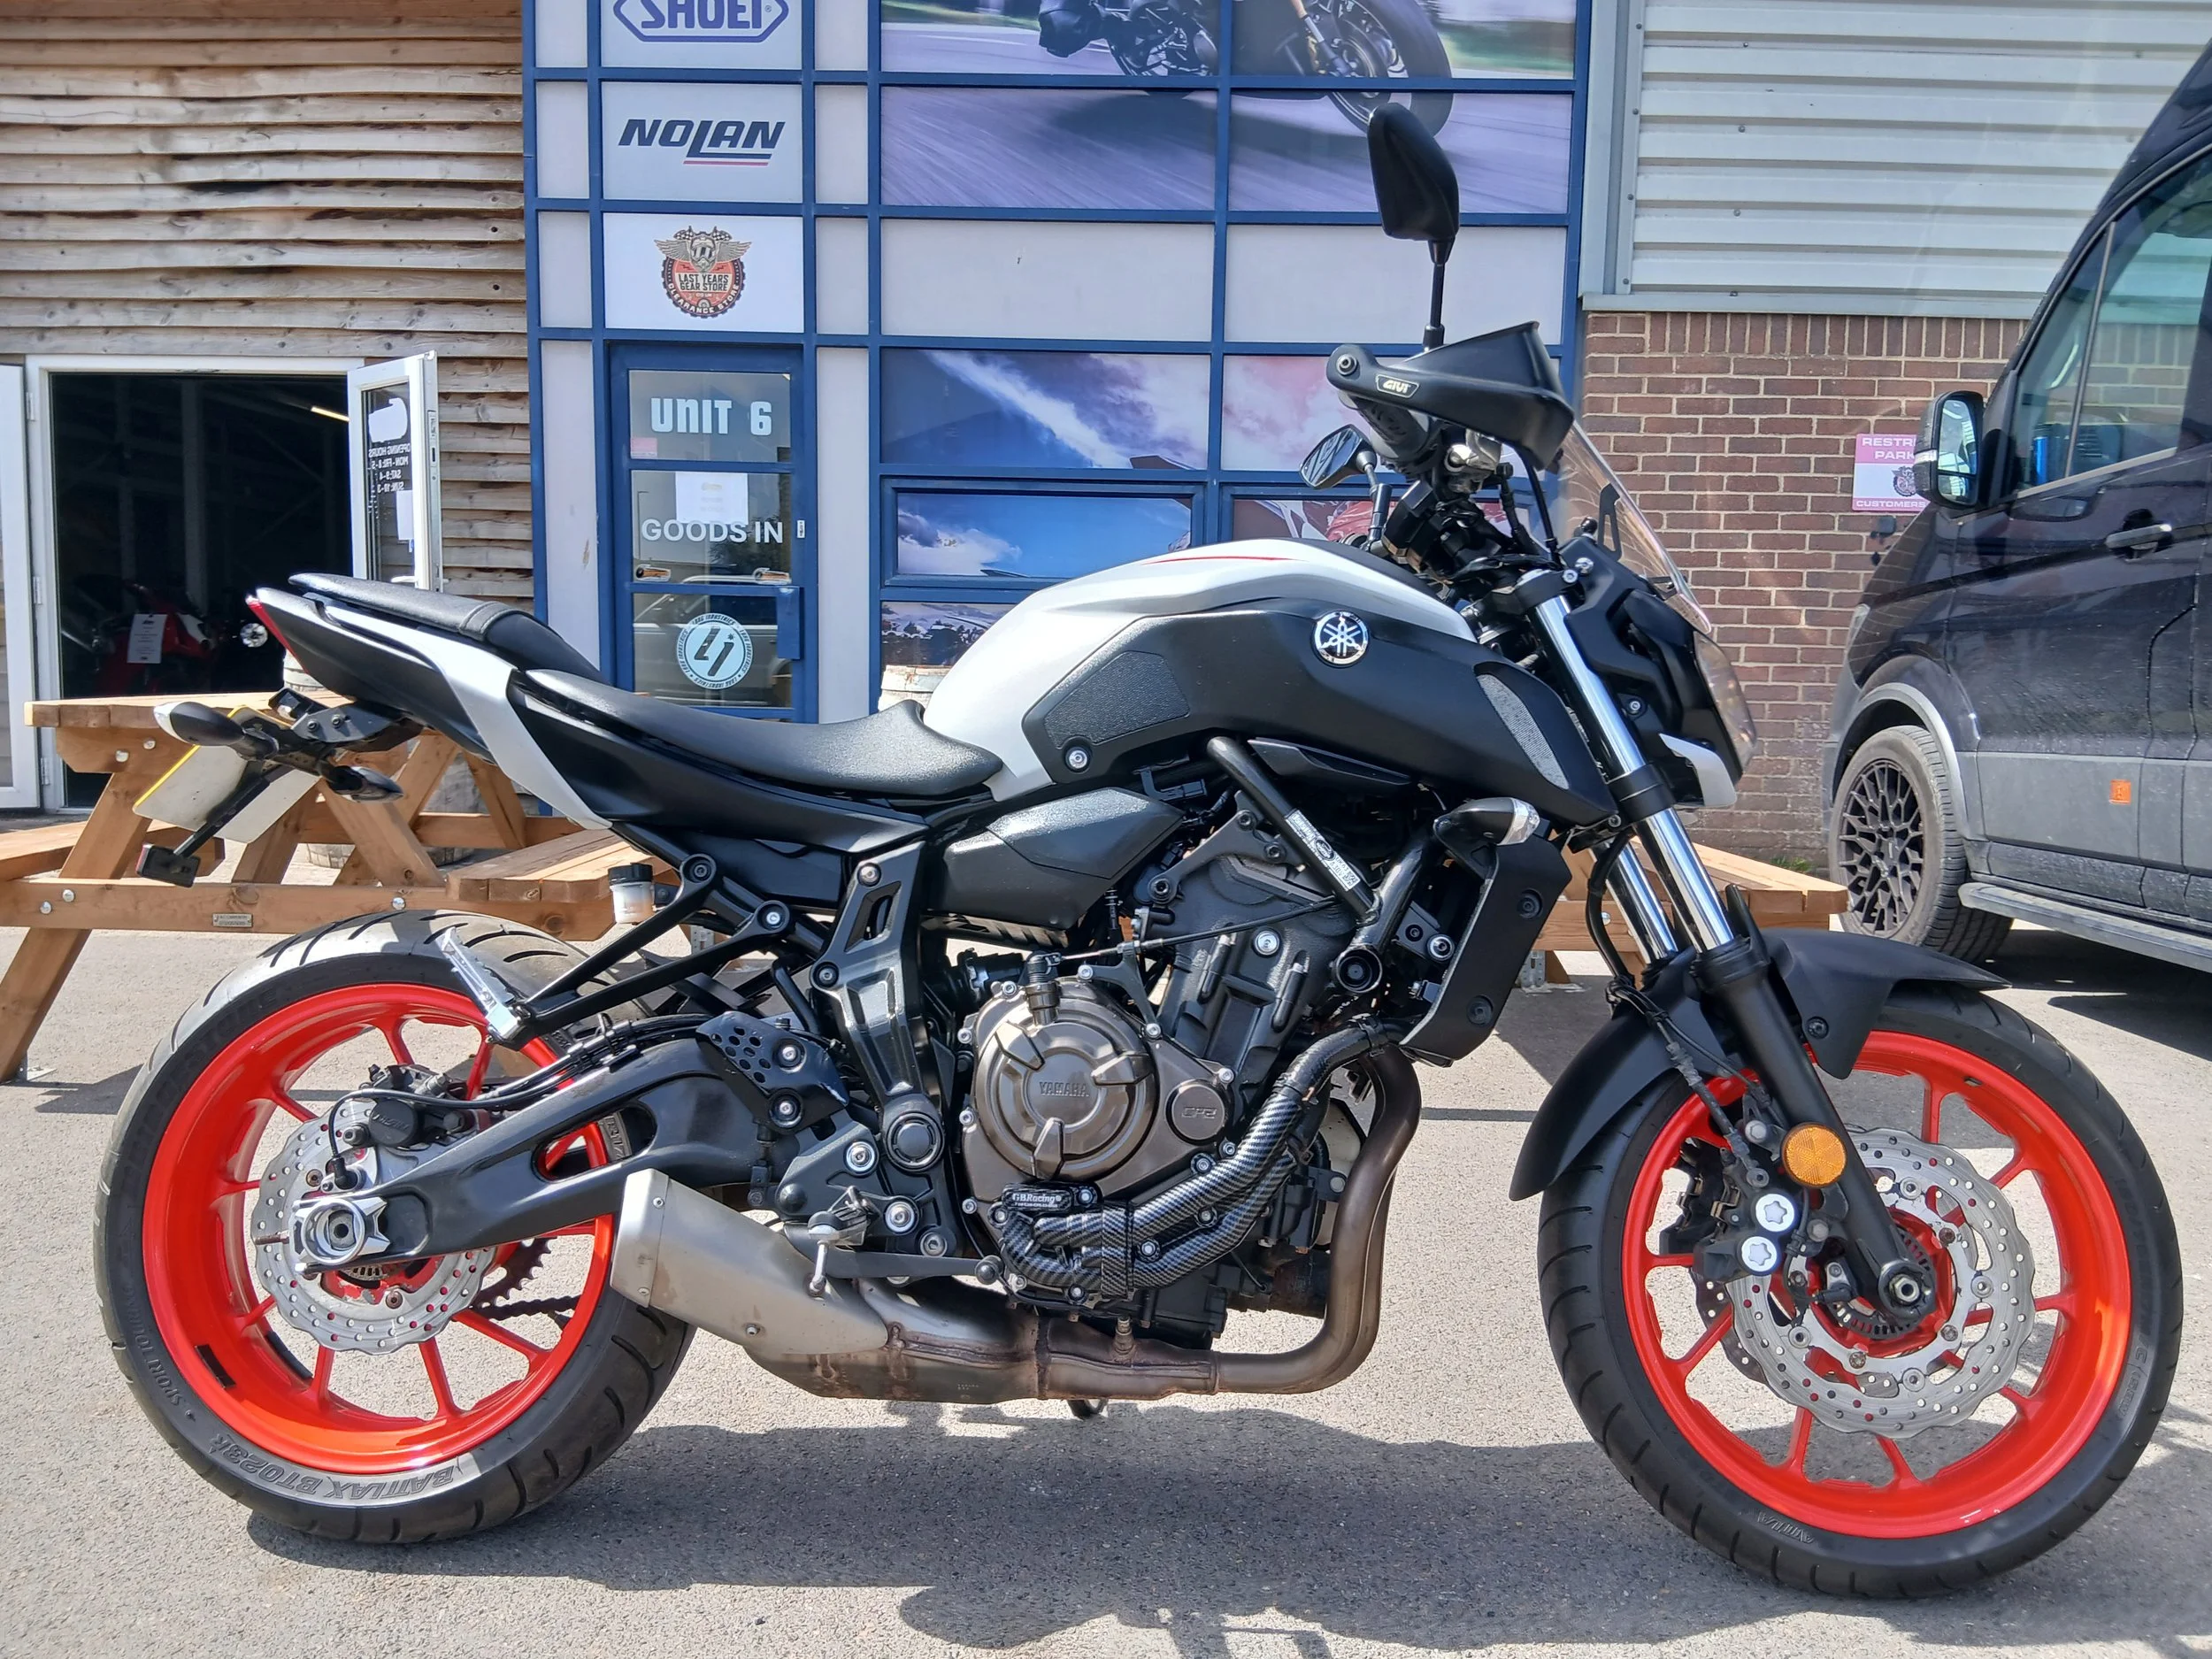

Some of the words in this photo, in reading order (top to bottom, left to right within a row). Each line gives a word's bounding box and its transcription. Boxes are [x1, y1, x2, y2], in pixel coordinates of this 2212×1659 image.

[641, 0, 762, 29] SHOEI
[618, 119, 786, 159] NOLAN
[679, 273, 699, 283] LAST
[702, 274, 728, 283] YEARS
[668, 283, 715, 313] CLEARANCE
[718, 283, 740, 311] STORE
[1383, 380, 1411, 394] GIVI
[650, 397, 732, 434] UNIT
[750, 401, 772, 436] 6
[1862, 437, 1916, 447] RESTRI
[1874, 450, 1915, 459] PARK
[1855, 500, 1926, 509] CUSTOMERS
[641, 518, 748, 543] GOODS
[755, 521, 783, 544] IN
[1039, 1081, 1090, 1097] YAMAHA
[148, 1359, 181, 1406] SPORT
[324, 1465, 454, 1501] BATTLAX
